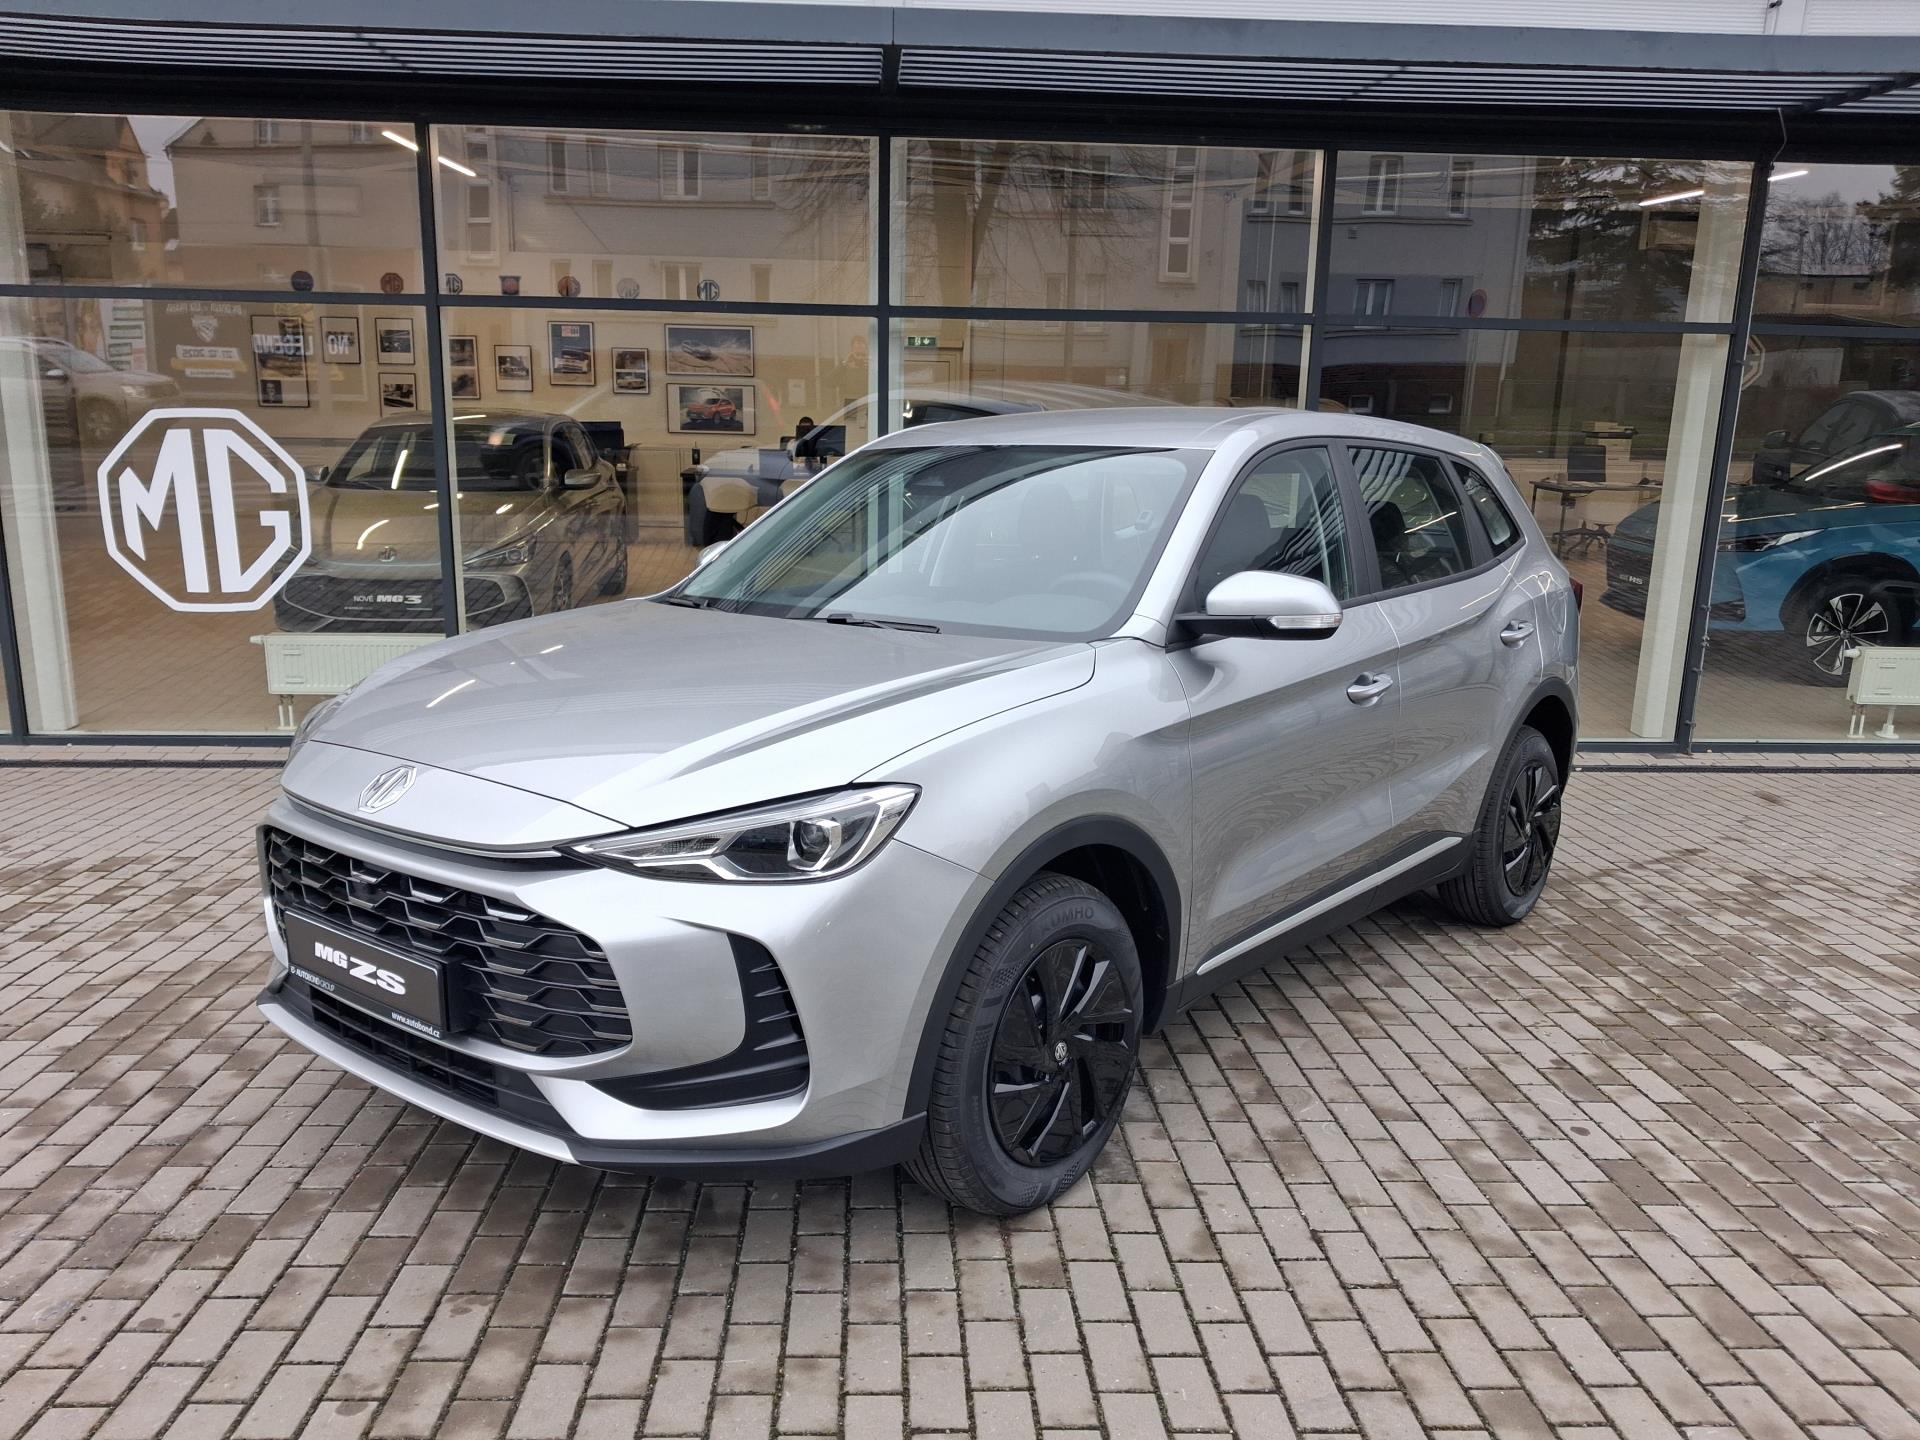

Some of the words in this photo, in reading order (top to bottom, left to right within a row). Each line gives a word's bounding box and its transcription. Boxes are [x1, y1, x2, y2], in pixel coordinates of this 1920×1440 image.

[699, 281, 718, 300] MG
[117, 426, 292, 594] MG
[314, 941, 348, 969] MG
[349, 956, 406, 995] ZS
[391, 1011, 440, 1038] www.autobond.cz
